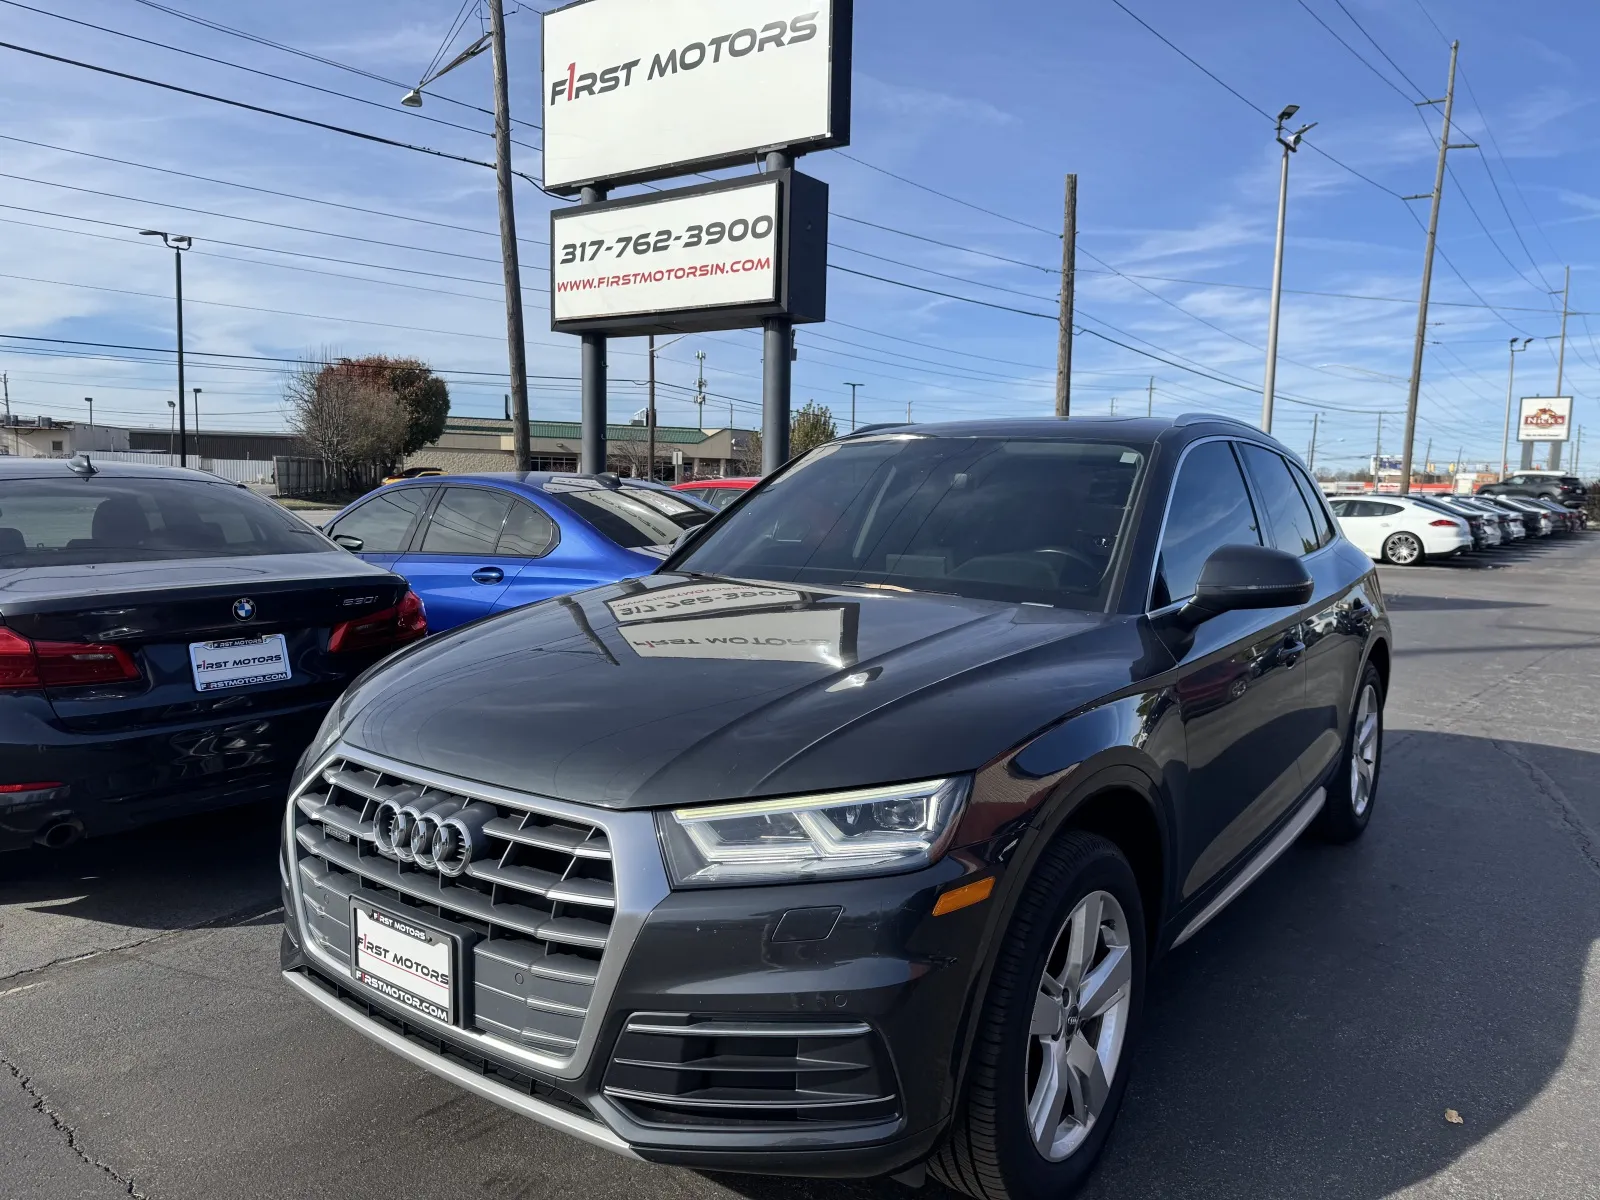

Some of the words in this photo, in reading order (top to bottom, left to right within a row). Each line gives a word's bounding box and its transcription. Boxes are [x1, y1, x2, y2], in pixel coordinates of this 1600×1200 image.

[647, 10, 820, 81] MOTORS
[560, 214, 774, 265] 317-762-3900
[557, 257, 771, 293] WWW.FIRSTMOTORSIN.COM
[234, 638, 263, 646] MOTORS
[232, 654, 282, 667] MOTORS
[394, 921, 426, 940] MOTORS
[392, 953, 449, 985] MOTORS
